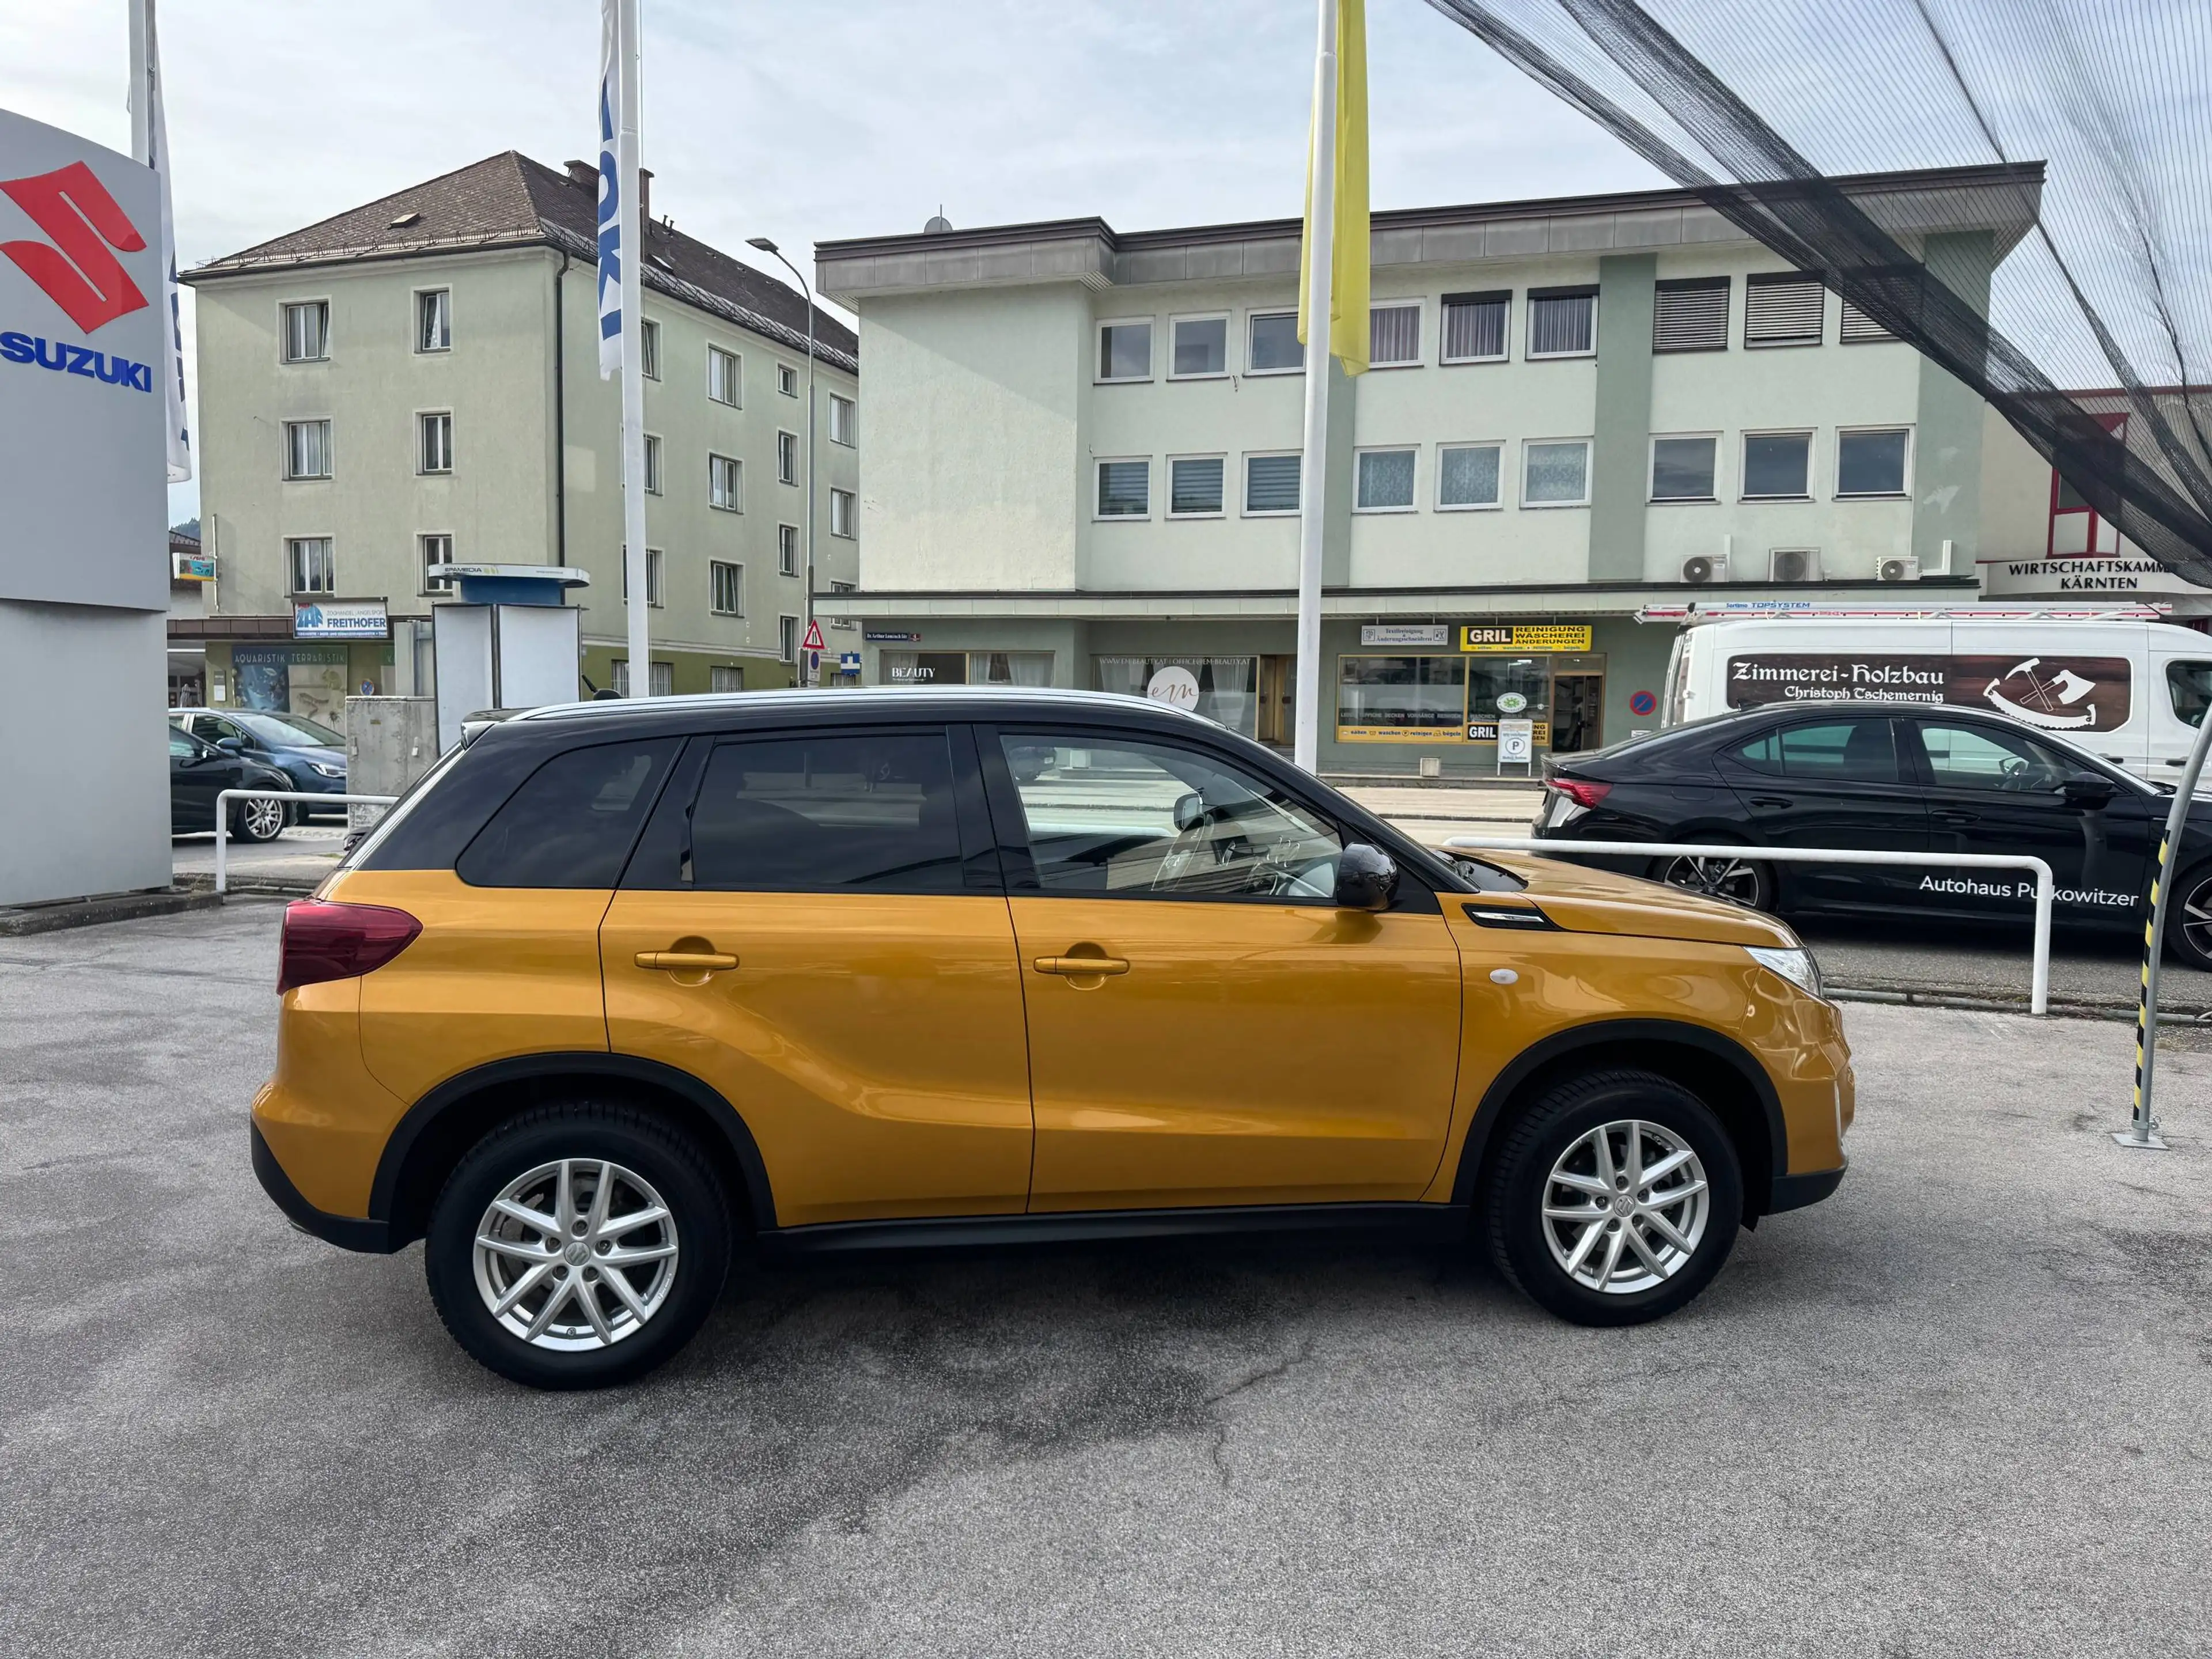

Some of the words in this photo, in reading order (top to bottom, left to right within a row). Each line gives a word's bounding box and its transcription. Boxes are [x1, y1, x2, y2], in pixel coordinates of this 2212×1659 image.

[0, 331, 151, 393] SUZUKI
[2009, 560, 2172, 575] WIRTSCHAFTSKAMM
[2061, 575, 2138, 589] KÄRNTEN
[327, 618, 386, 628] FREITHOFER
[1469, 629, 1512, 643] GRIL
[234, 654, 286, 663] AQUARISTIK
[291, 653, 345, 662] TERRARISTIK
[892, 667, 935, 677] BEAUTY
[1785, 685, 1850, 700] Christoph
[1853, 687, 1944, 703] Tschemernig
[1469, 726, 1497, 738] GRIL
[1919, 875, 2011, 896] Autohaus
[2017, 882, 2139, 907] Pukowitzer
